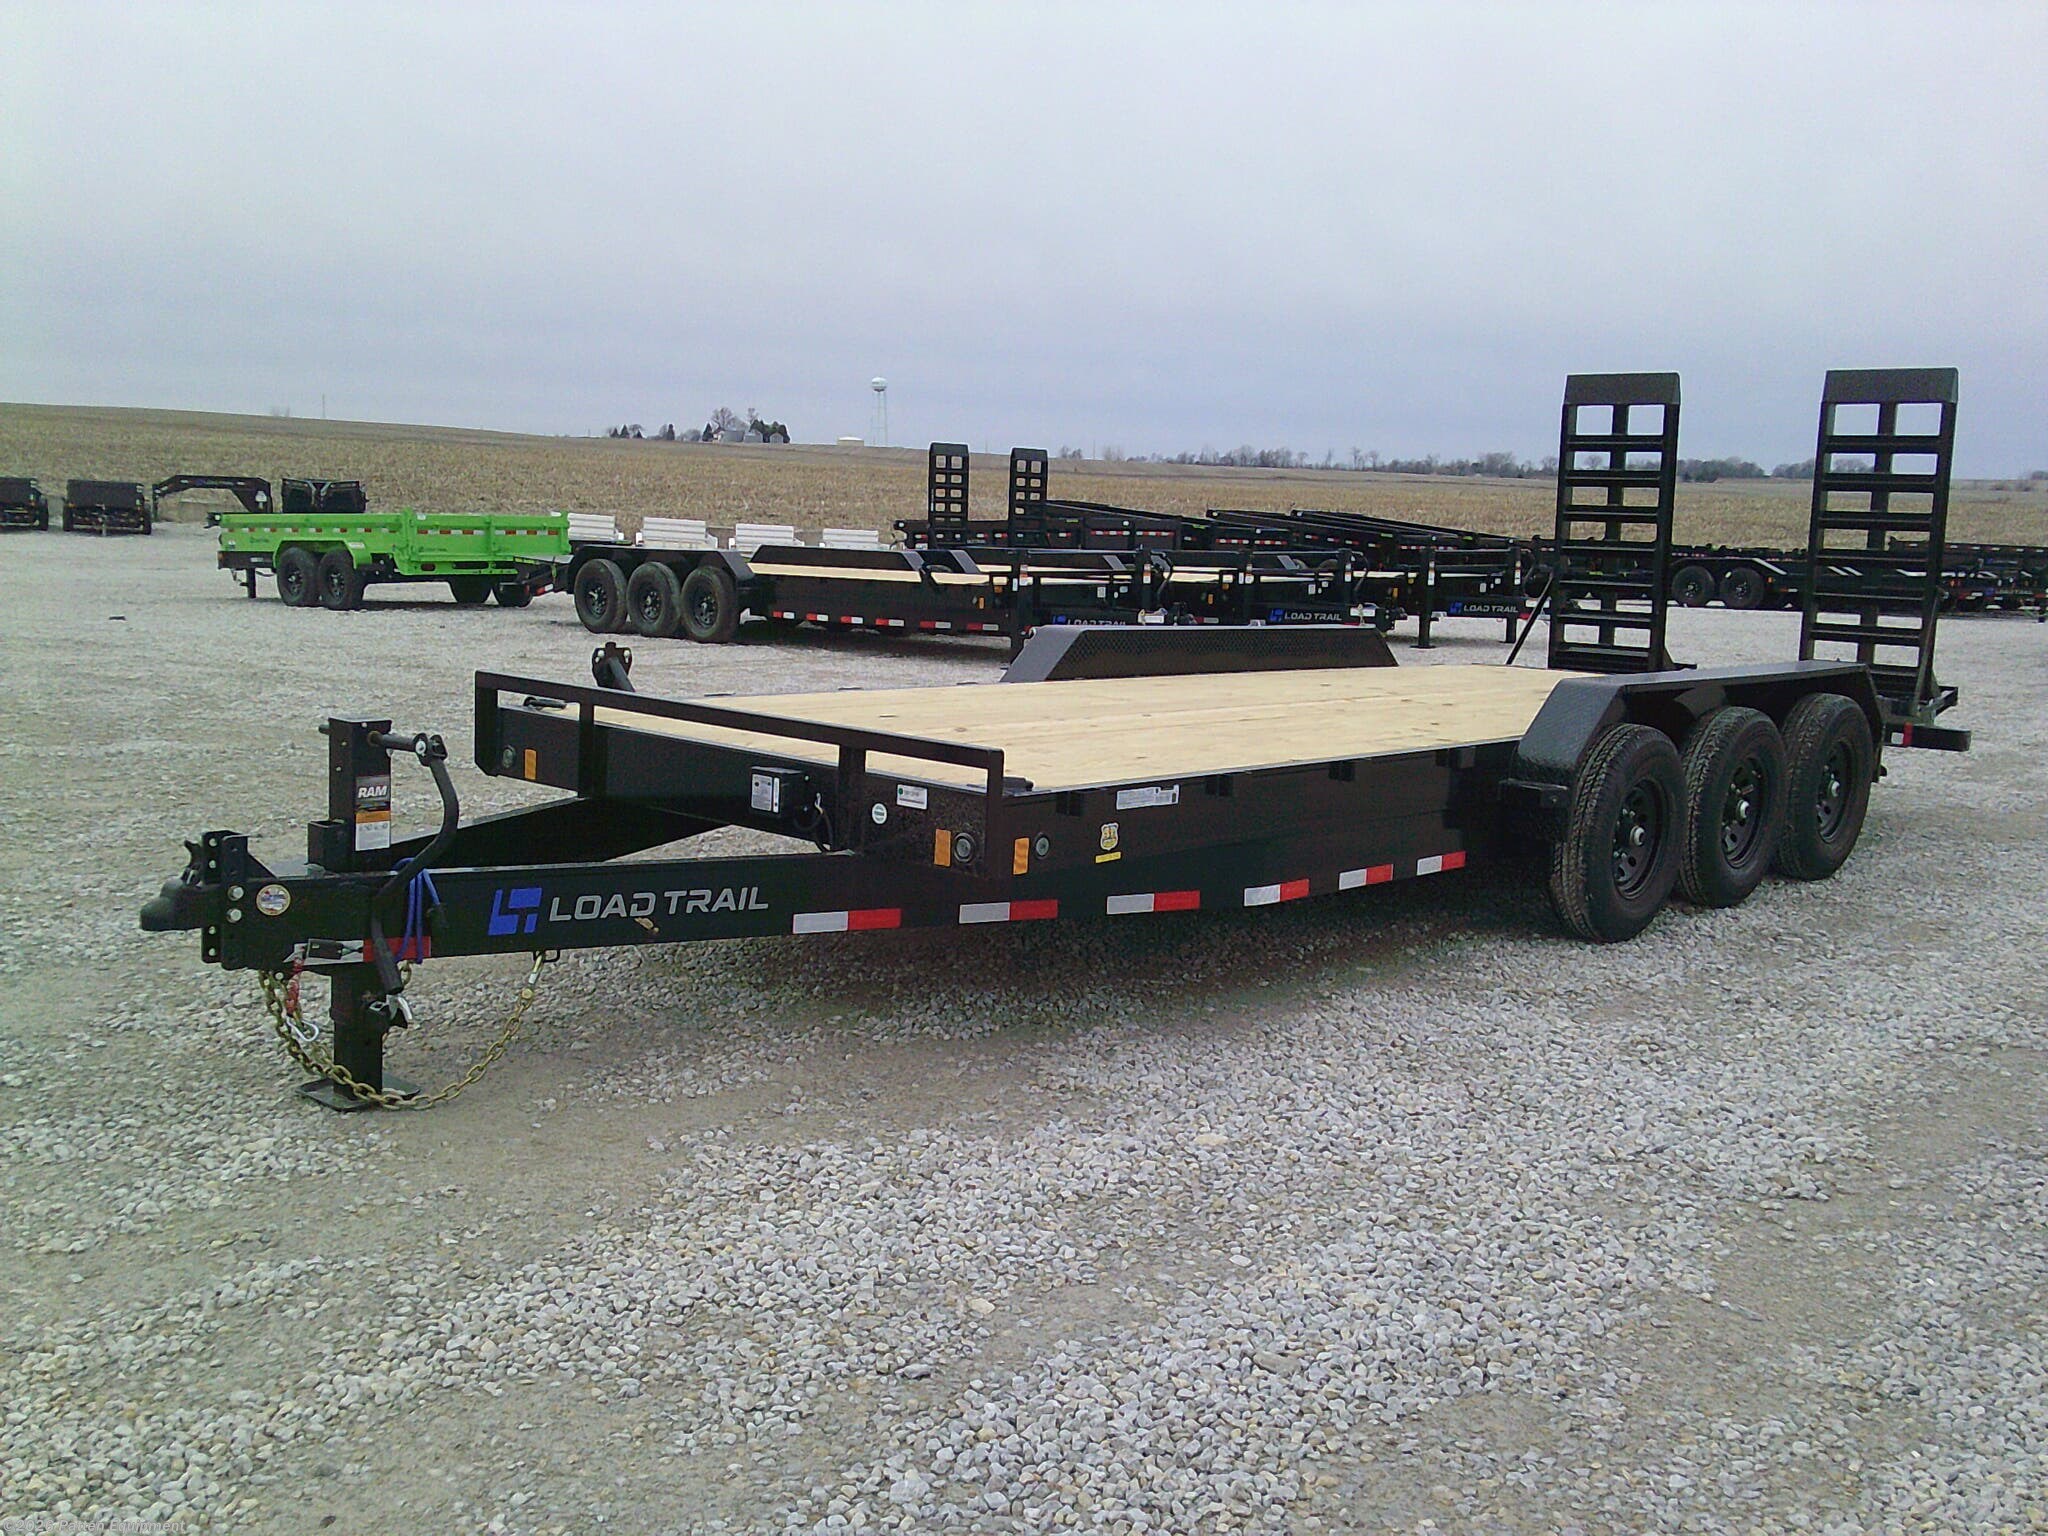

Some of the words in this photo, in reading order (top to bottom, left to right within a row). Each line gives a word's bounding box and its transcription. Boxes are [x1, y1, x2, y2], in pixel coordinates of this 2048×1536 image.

[1464, 604, 1490, 612] LOAD
[1491, 605, 1519, 613] TRAIL
[1284, 611, 1313, 621] LOAD
[1314, 612, 1343, 621] TRAIL
[358, 785, 388, 799] RAM
[549, 892, 656, 922] LOAD
[663, 886, 769, 915] TRAIL
